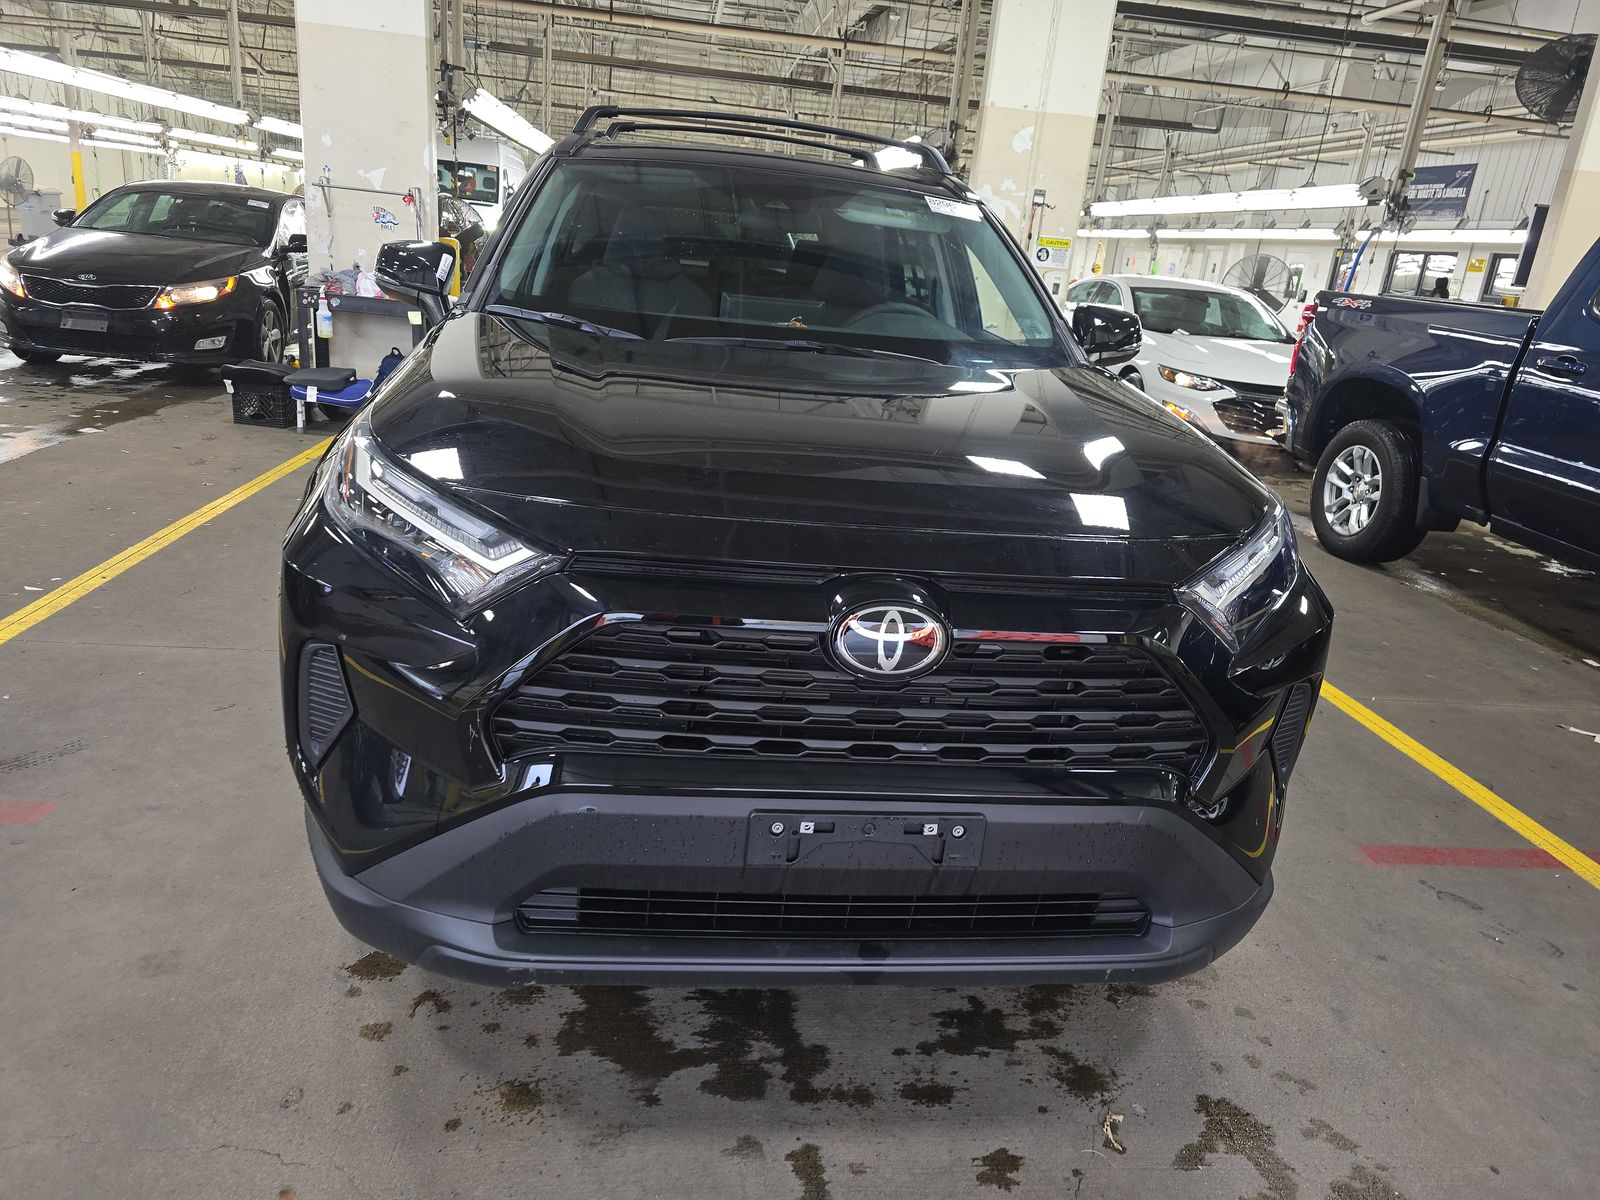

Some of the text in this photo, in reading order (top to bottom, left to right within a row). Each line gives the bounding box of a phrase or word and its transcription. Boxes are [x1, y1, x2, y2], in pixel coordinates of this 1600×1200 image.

[1417, 188, 1434, 199] WASTE
[1435, 188, 1442, 199] TO
[1443, 187, 1467, 198] LANDFILL
[1045, 239, 1069, 247] CAUTION
